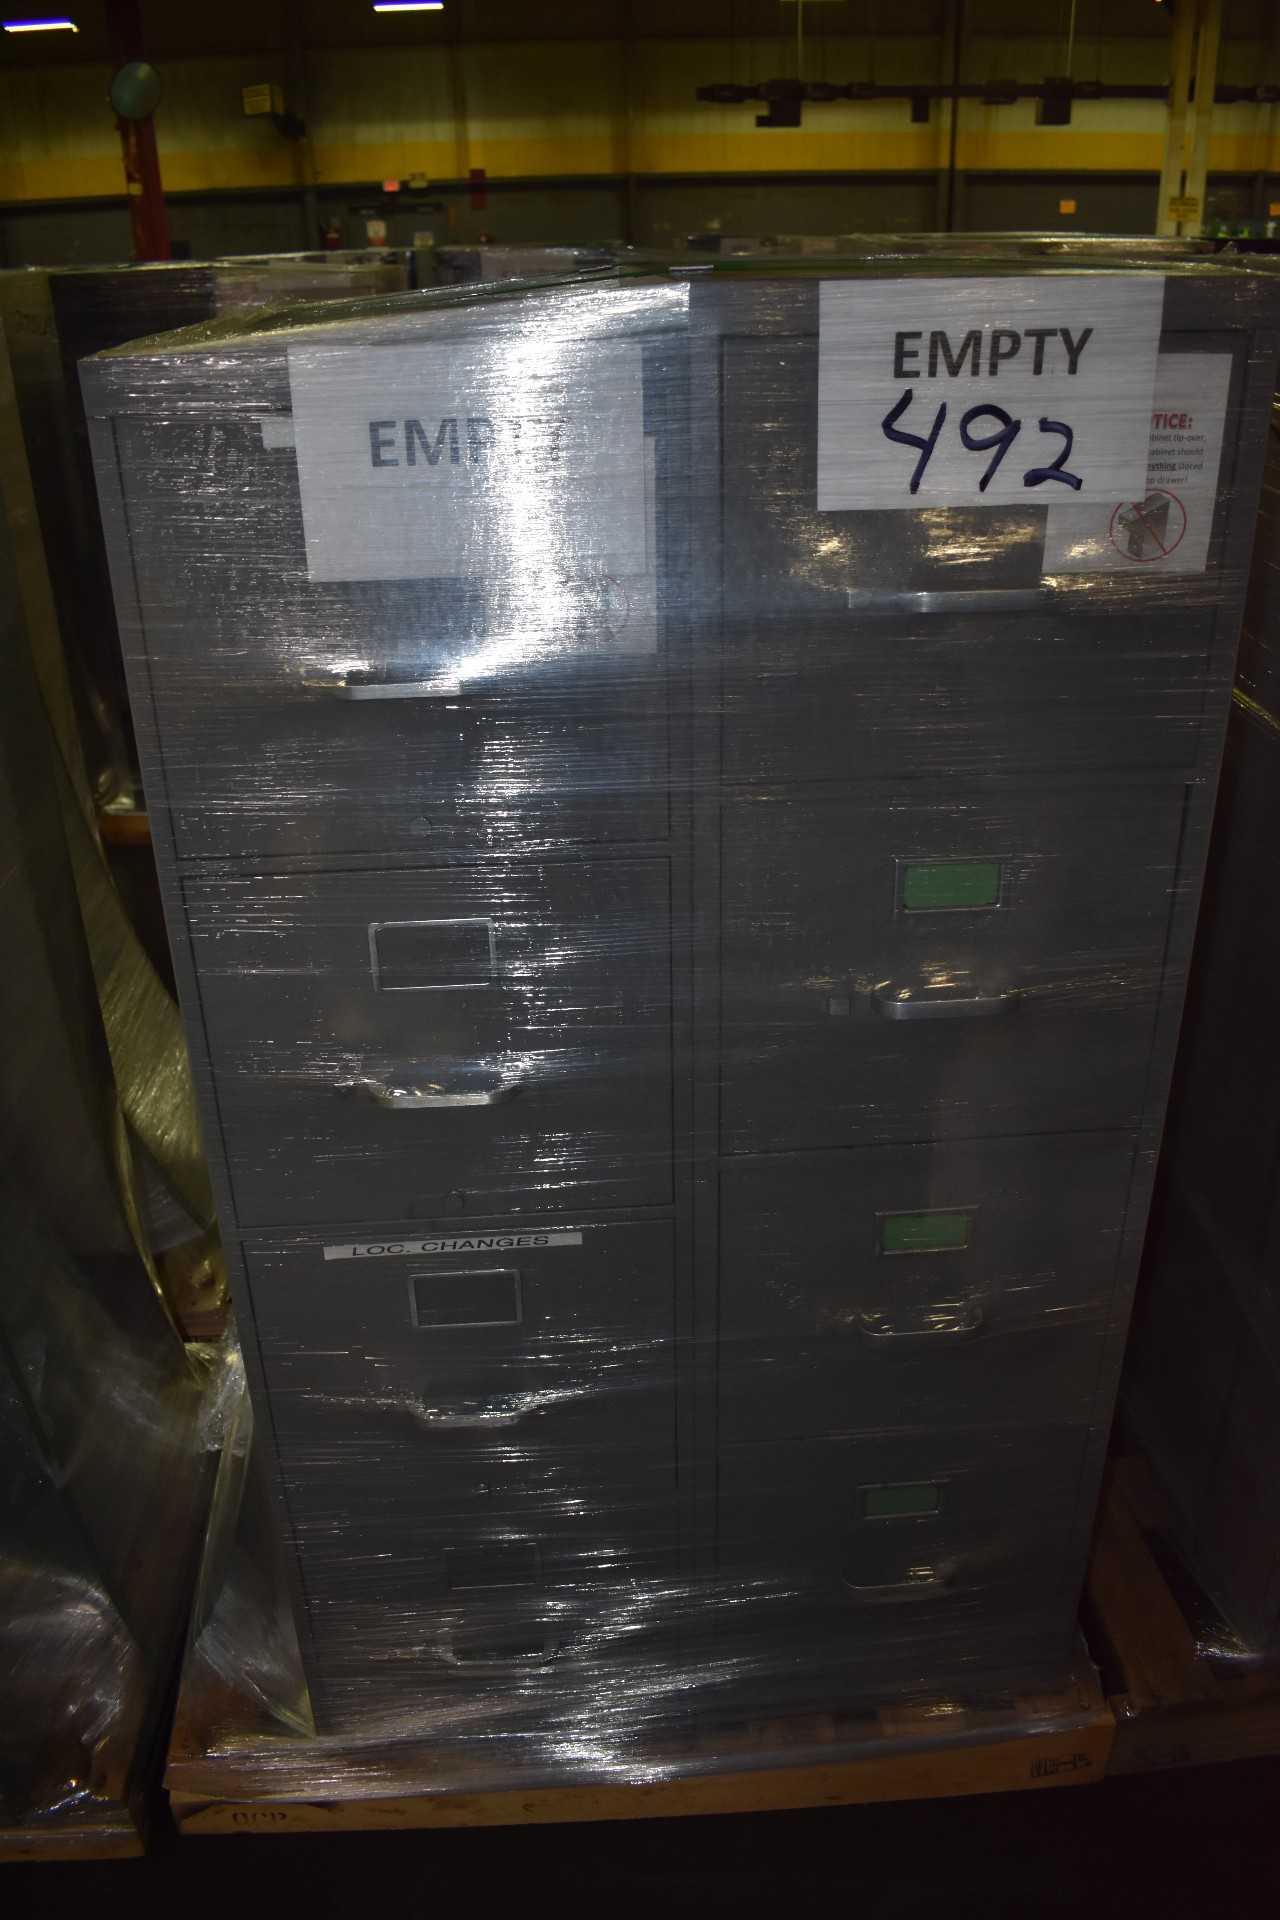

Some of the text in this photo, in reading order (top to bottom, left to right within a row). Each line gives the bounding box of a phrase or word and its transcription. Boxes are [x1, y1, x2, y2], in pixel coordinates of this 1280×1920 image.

[893, 327, 1094, 379] EMPTY
[368, 417, 571, 468] EMP
[881, 388, 1083, 494] 492
[351, 1235, 550, 1256] LOC. CHANGES
